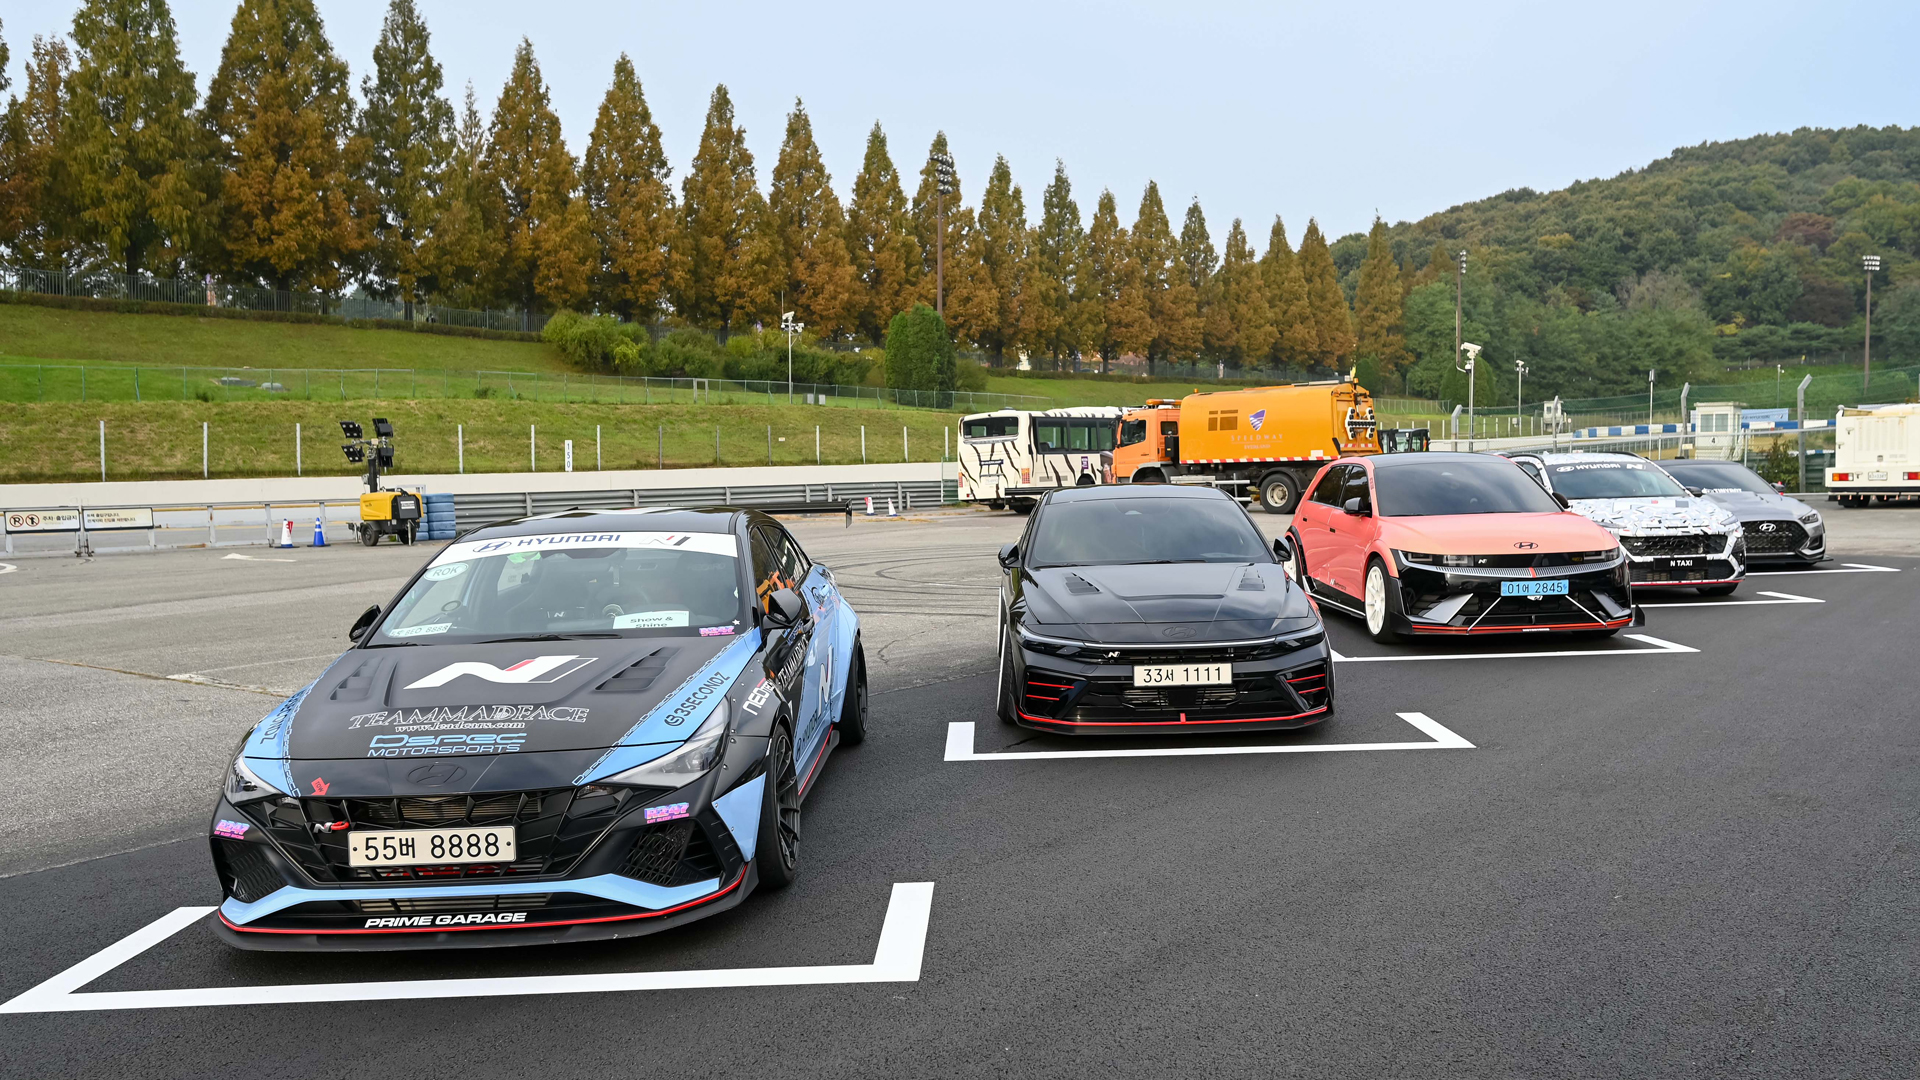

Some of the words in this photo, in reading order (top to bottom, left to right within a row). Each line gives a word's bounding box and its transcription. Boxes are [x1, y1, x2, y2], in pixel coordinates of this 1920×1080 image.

[1231, 433, 1283, 442] SPEEDWAY
[517, 534, 621, 547] HYUNDAI
[432, 566, 460, 578] ROK
[1507, 583, 1530, 594] 01어
[1535, 582, 1563, 593] 2845
[1143, 668, 1175, 683] 33서
[1183, 666, 1222, 682] 1111
[348, 705, 590, 730] TEAMMADFACE
[395, 720, 526, 733] www.leadcars.com
[367, 744, 521, 758] MOTORSPORTS
[364, 836, 416, 861] 55버
[430, 832, 500, 859] 8888
[364, 915, 434, 928] PRIME
[435, 912, 528, 925] GARAGE
